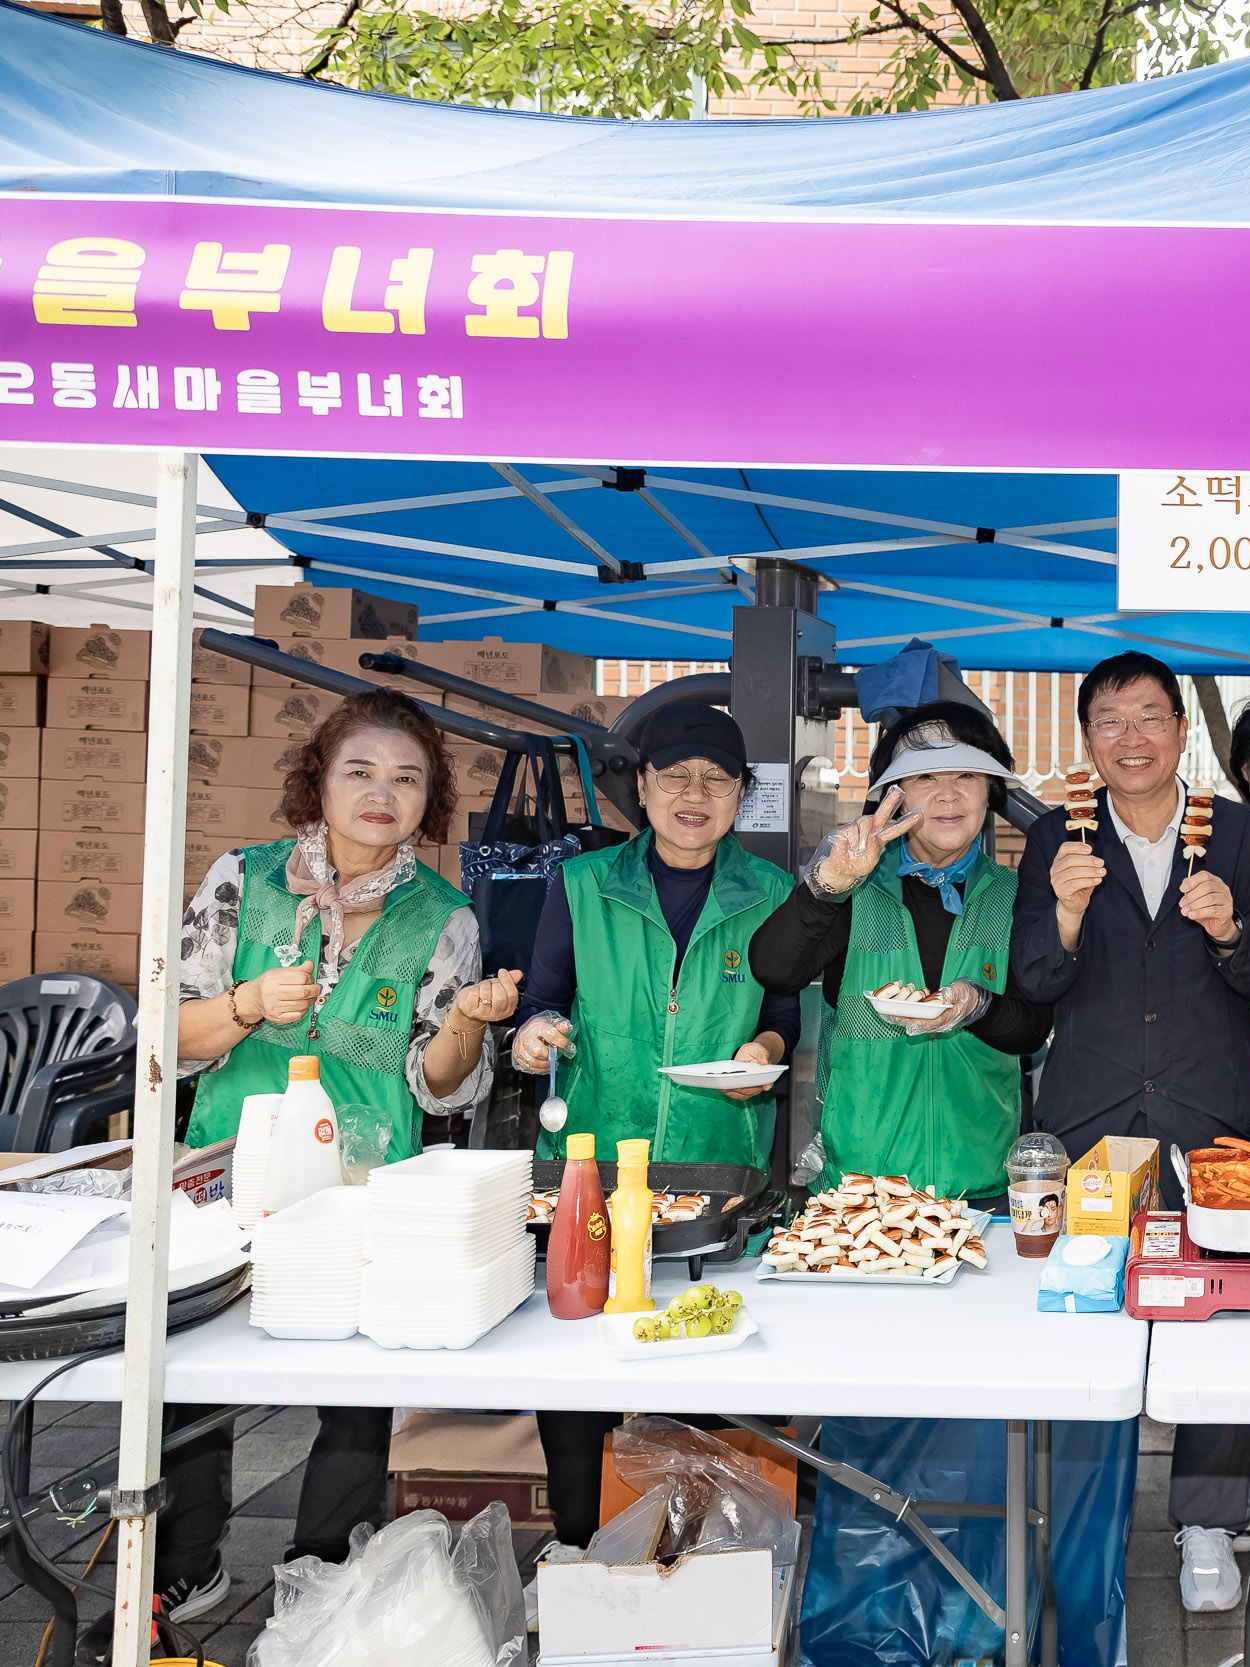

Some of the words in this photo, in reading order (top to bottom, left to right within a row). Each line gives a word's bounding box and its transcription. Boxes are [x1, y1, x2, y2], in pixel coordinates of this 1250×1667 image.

[33, 237, 574, 339] 을부녀회
[722, 972, 746, 983] SMU
[369, 1009, 398, 1023] SMU
